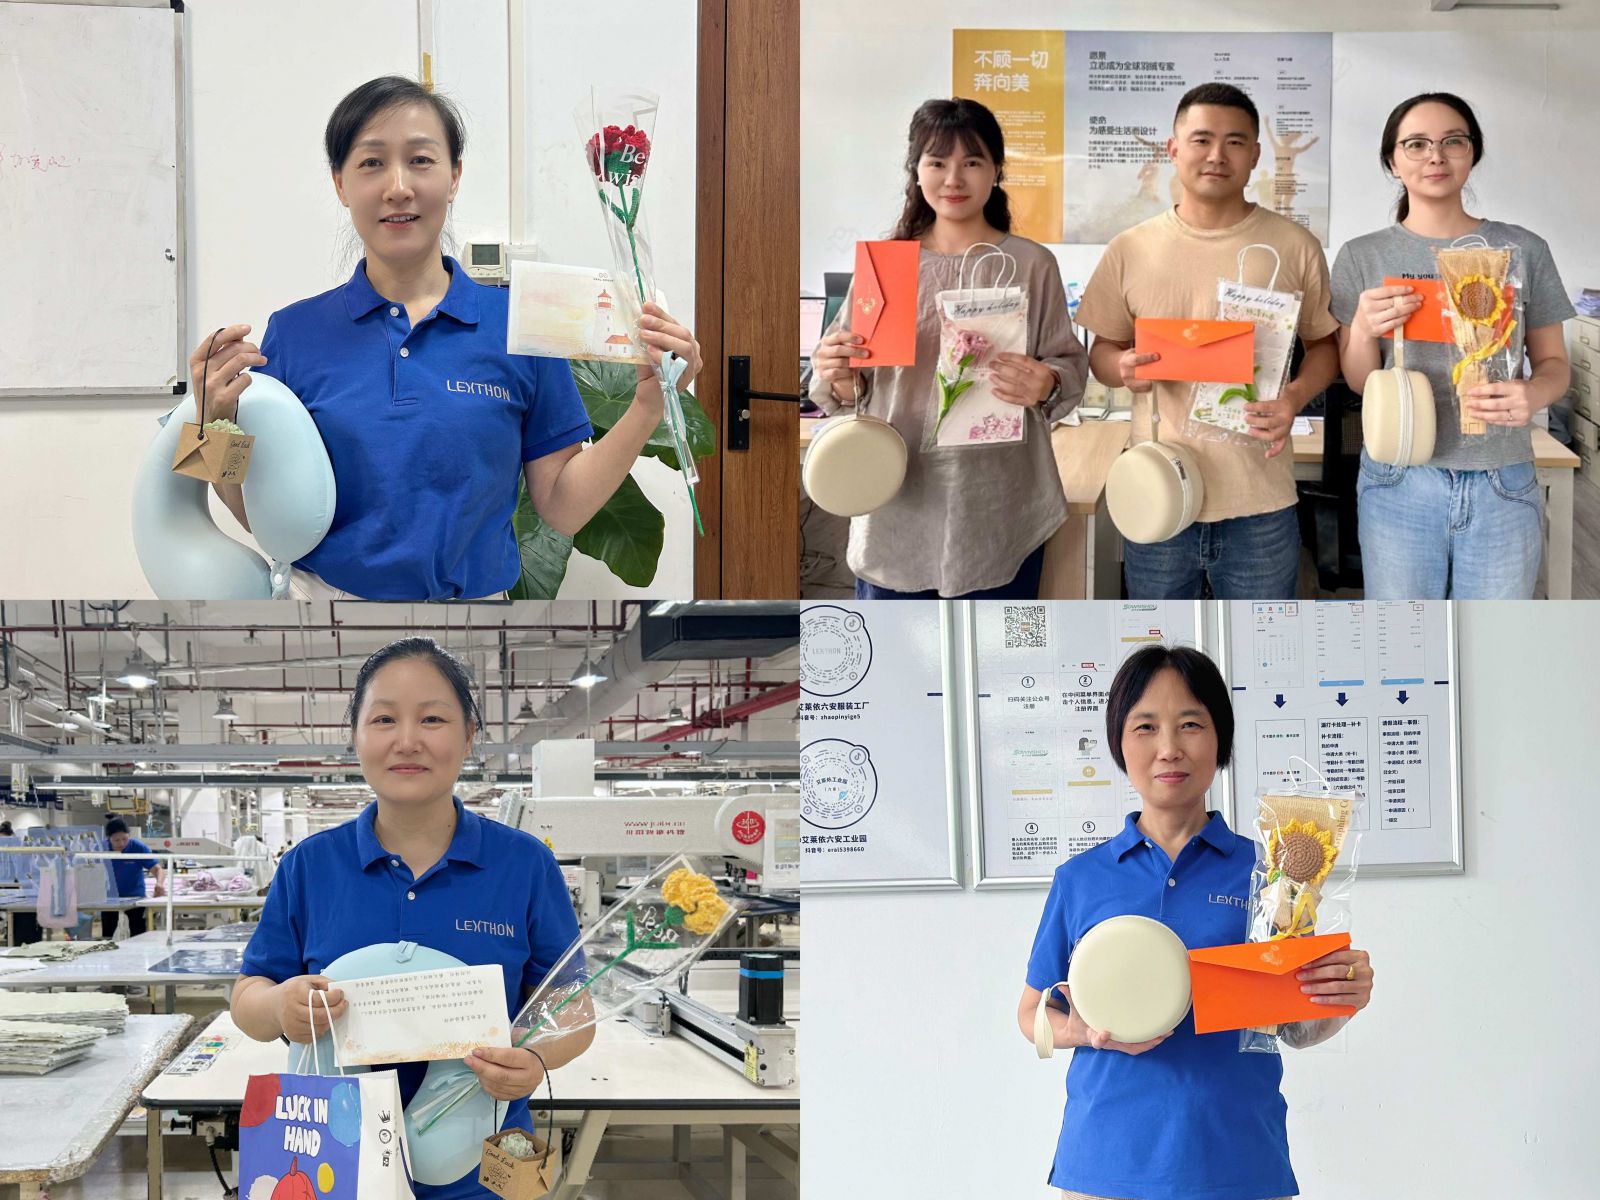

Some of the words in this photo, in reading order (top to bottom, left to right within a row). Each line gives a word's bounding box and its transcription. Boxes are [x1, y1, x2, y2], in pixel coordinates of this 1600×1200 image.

[974, 50, 1049, 69] 不顾一切
[974, 73, 1030, 93] 奔向美
[446, 379, 511, 402] LEXTHON
[1208, 893, 1249, 911] LEXTH
[455, 918, 515, 938] LEXTHON
[275, 1094, 312, 1122] LUCK
[314, 1097, 329, 1125] IN
[283, 1125, 321, 1158] HAND
